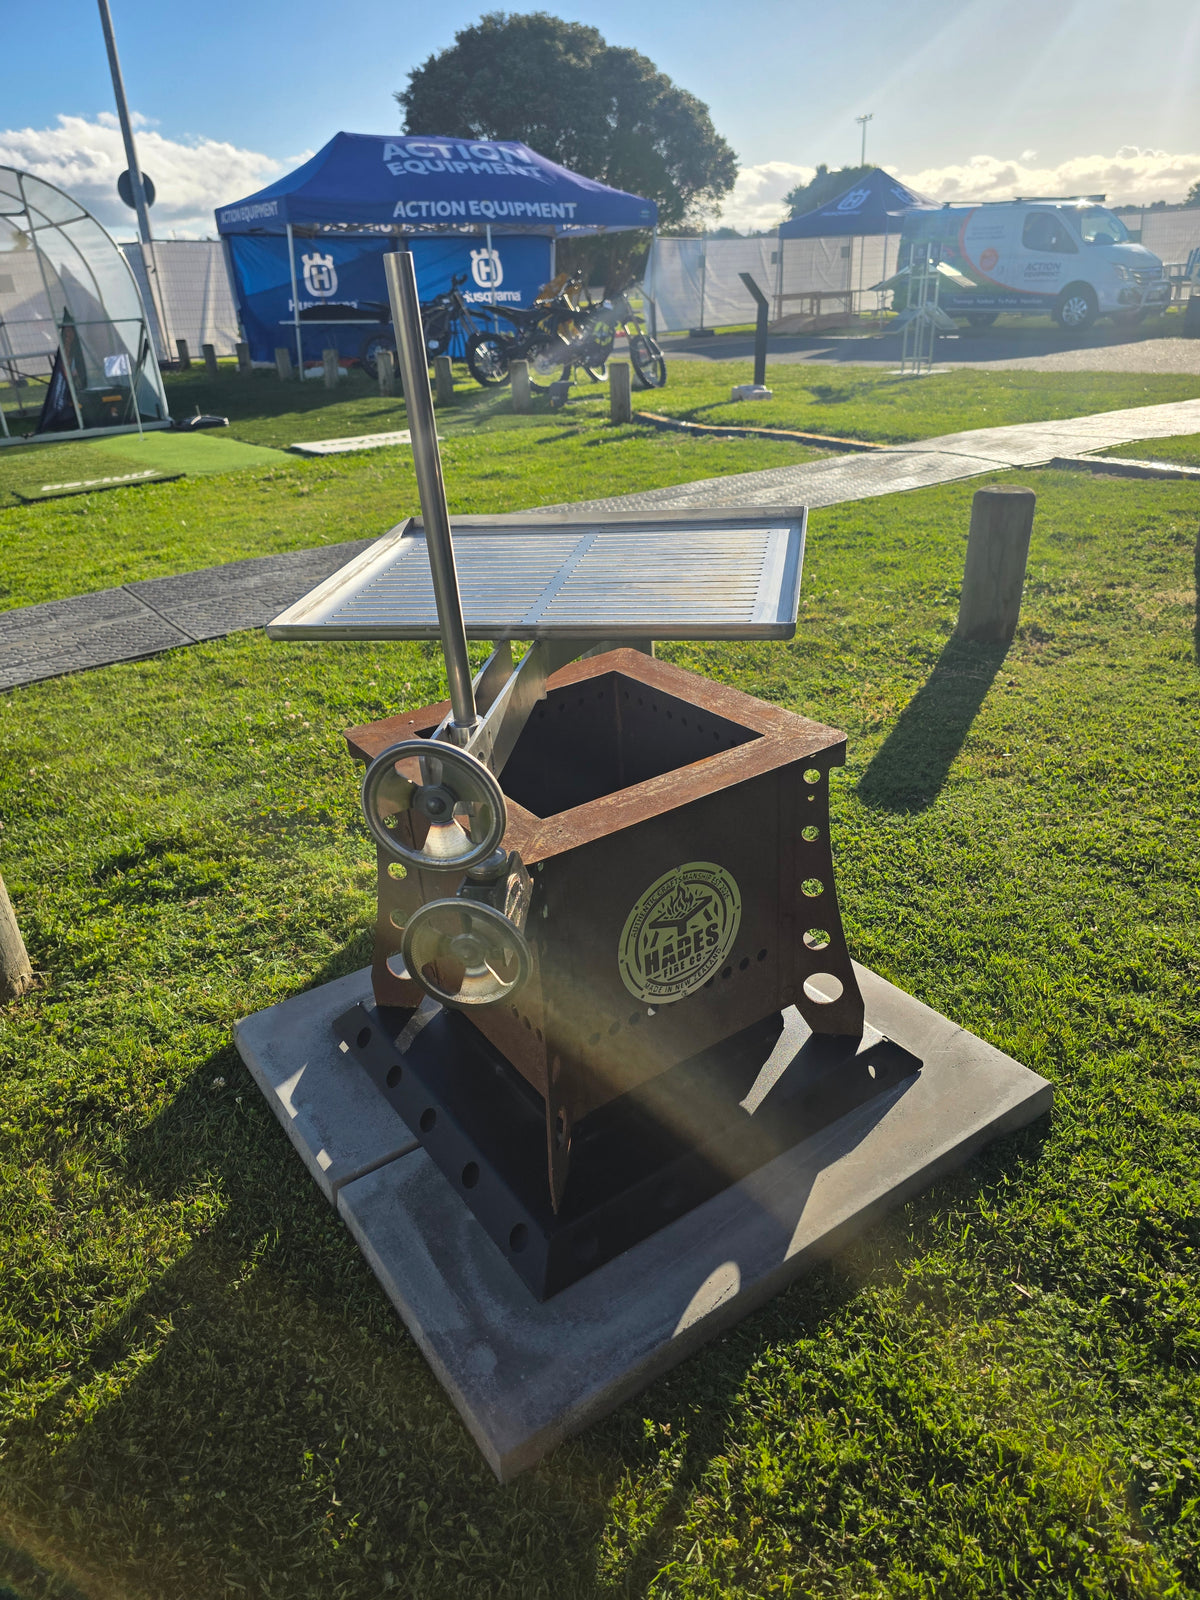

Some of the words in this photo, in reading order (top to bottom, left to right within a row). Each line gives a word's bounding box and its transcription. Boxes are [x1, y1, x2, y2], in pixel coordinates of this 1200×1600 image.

[383, 143, 532, 164] ACTION
[386, 159, 543, 178] EQUIPMENT
[393, 201, 466, 218] ACTION
[470, 201, 577, 219] EQUIPMENT
[1025, 262, 1061, 272] ACTION
[631, 896, 656, 938] AUTHENTIC
[657, 872, 712, 897] CRAFTSMANSHIP
[644, 922, 720, 977] HADES
[645, 981, 663, 994] MADE
[664, 985, 673, 993] IN
[675, 979, 691, 991] NEW
[693, 947, 722, 982] ZEALAND
[663, 960, 685, 978] FIRE
